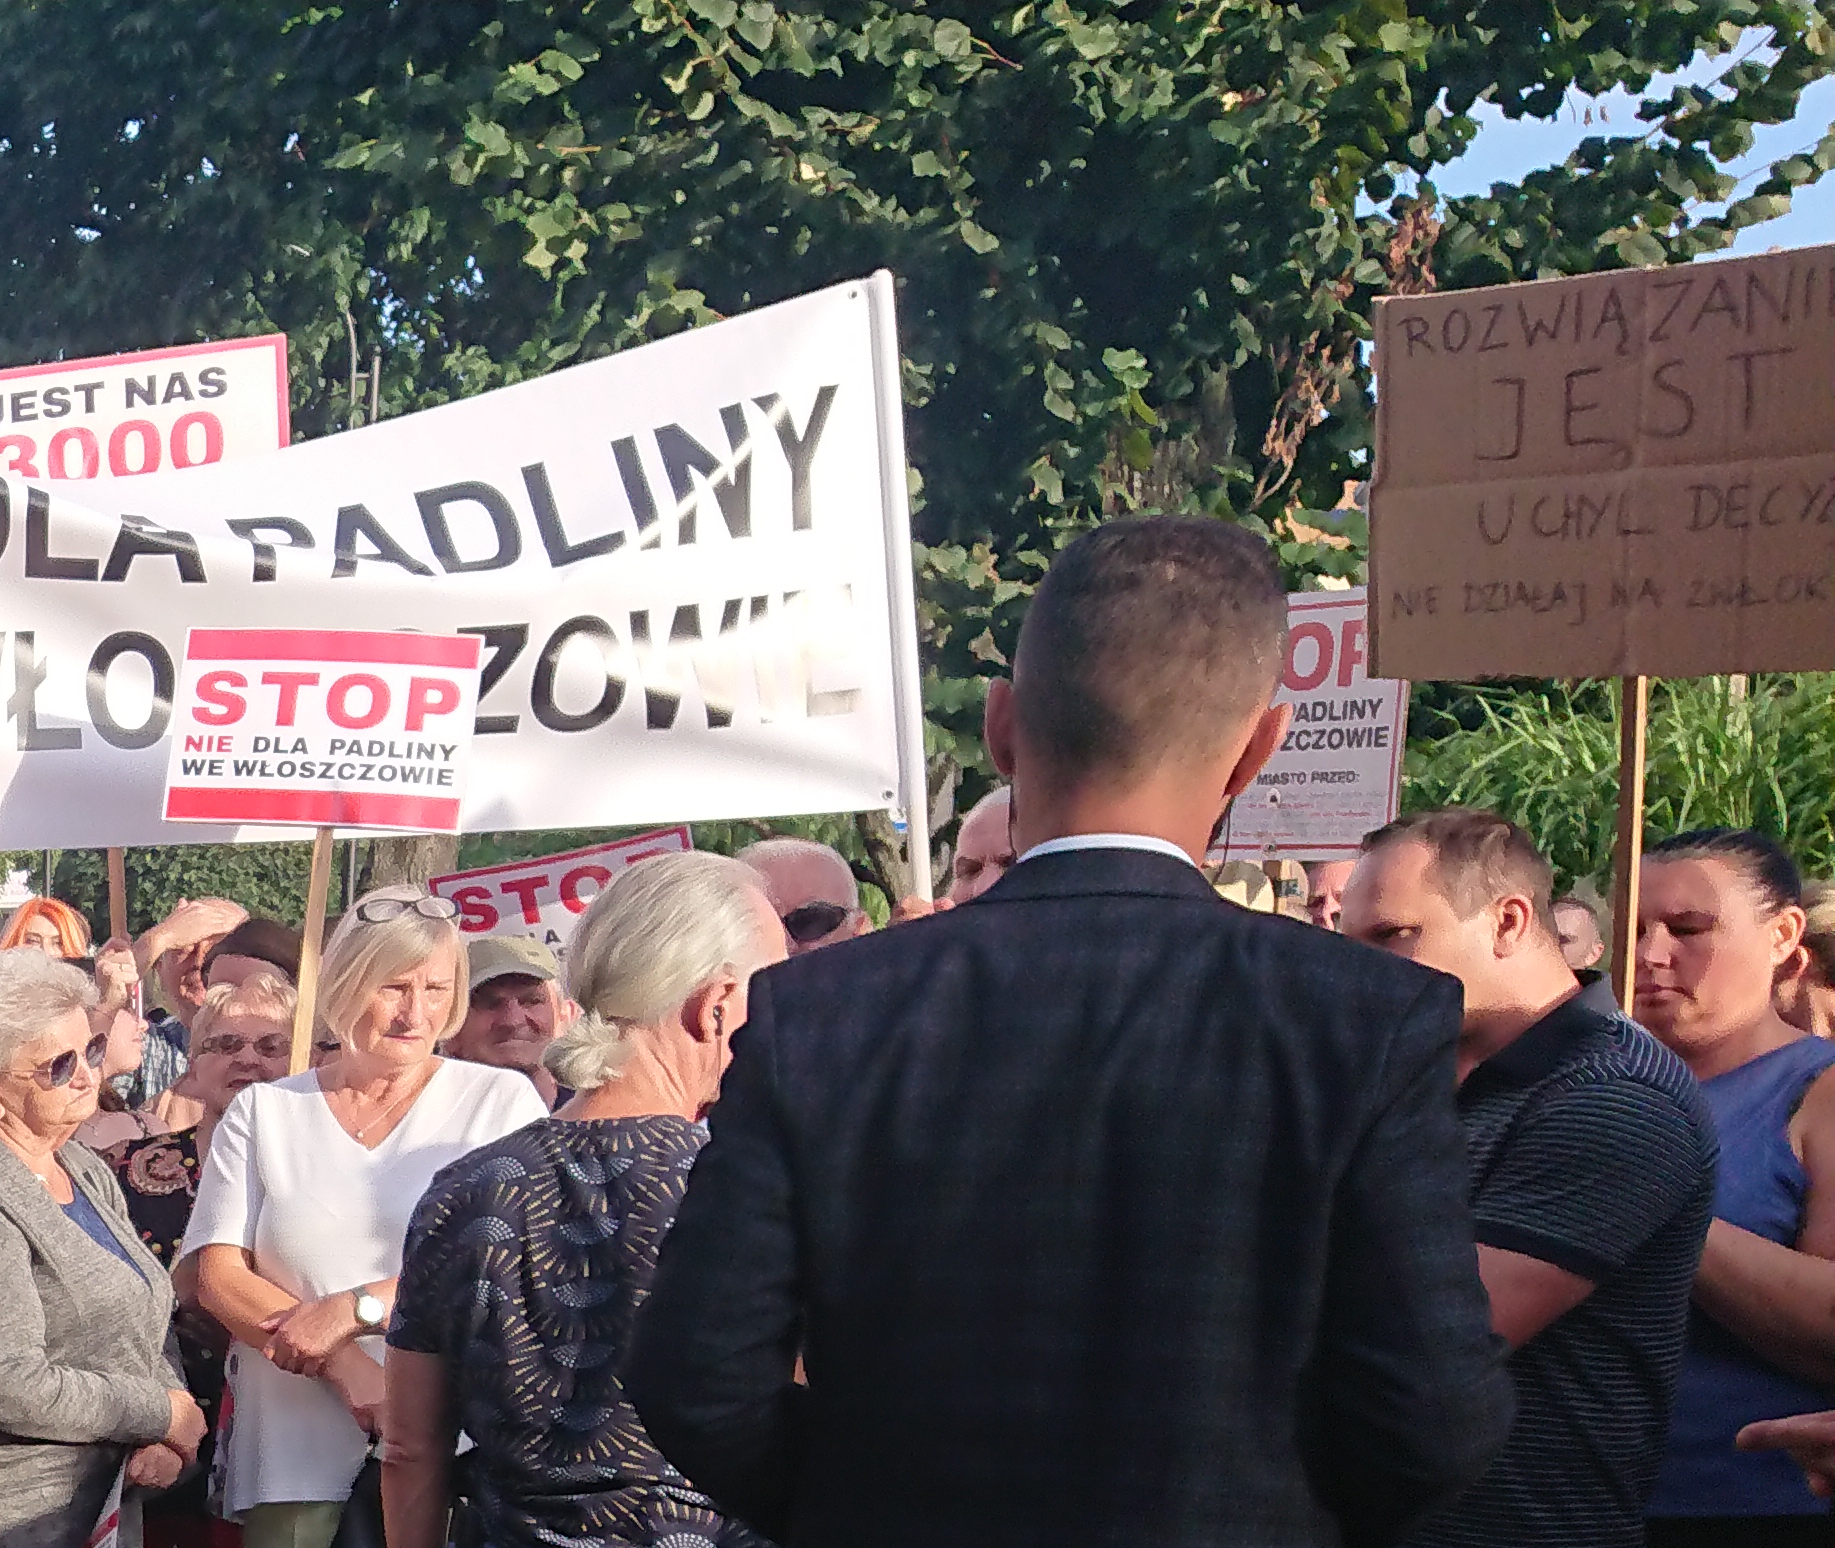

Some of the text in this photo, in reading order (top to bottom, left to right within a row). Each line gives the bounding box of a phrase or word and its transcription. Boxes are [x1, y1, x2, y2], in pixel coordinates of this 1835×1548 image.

[124, 366, 228, 409] NAS
[1476, 347, 1799, 461] JEST
[225, 383, 840, 582] PADLINY
[1282, 619, 1365, 691] OP
[191, 669, 462, 732] STOP
[1291, 698, 1384, 723] ADLINY
[184, 734, 459, 762] NIE DLA PADLINY
[1280, 725, 1390, 752] ZCZOWIE
[181, 758, 455, 787] WE WŁOSZCZOWIE
[452, 855, 671, 933] STO
